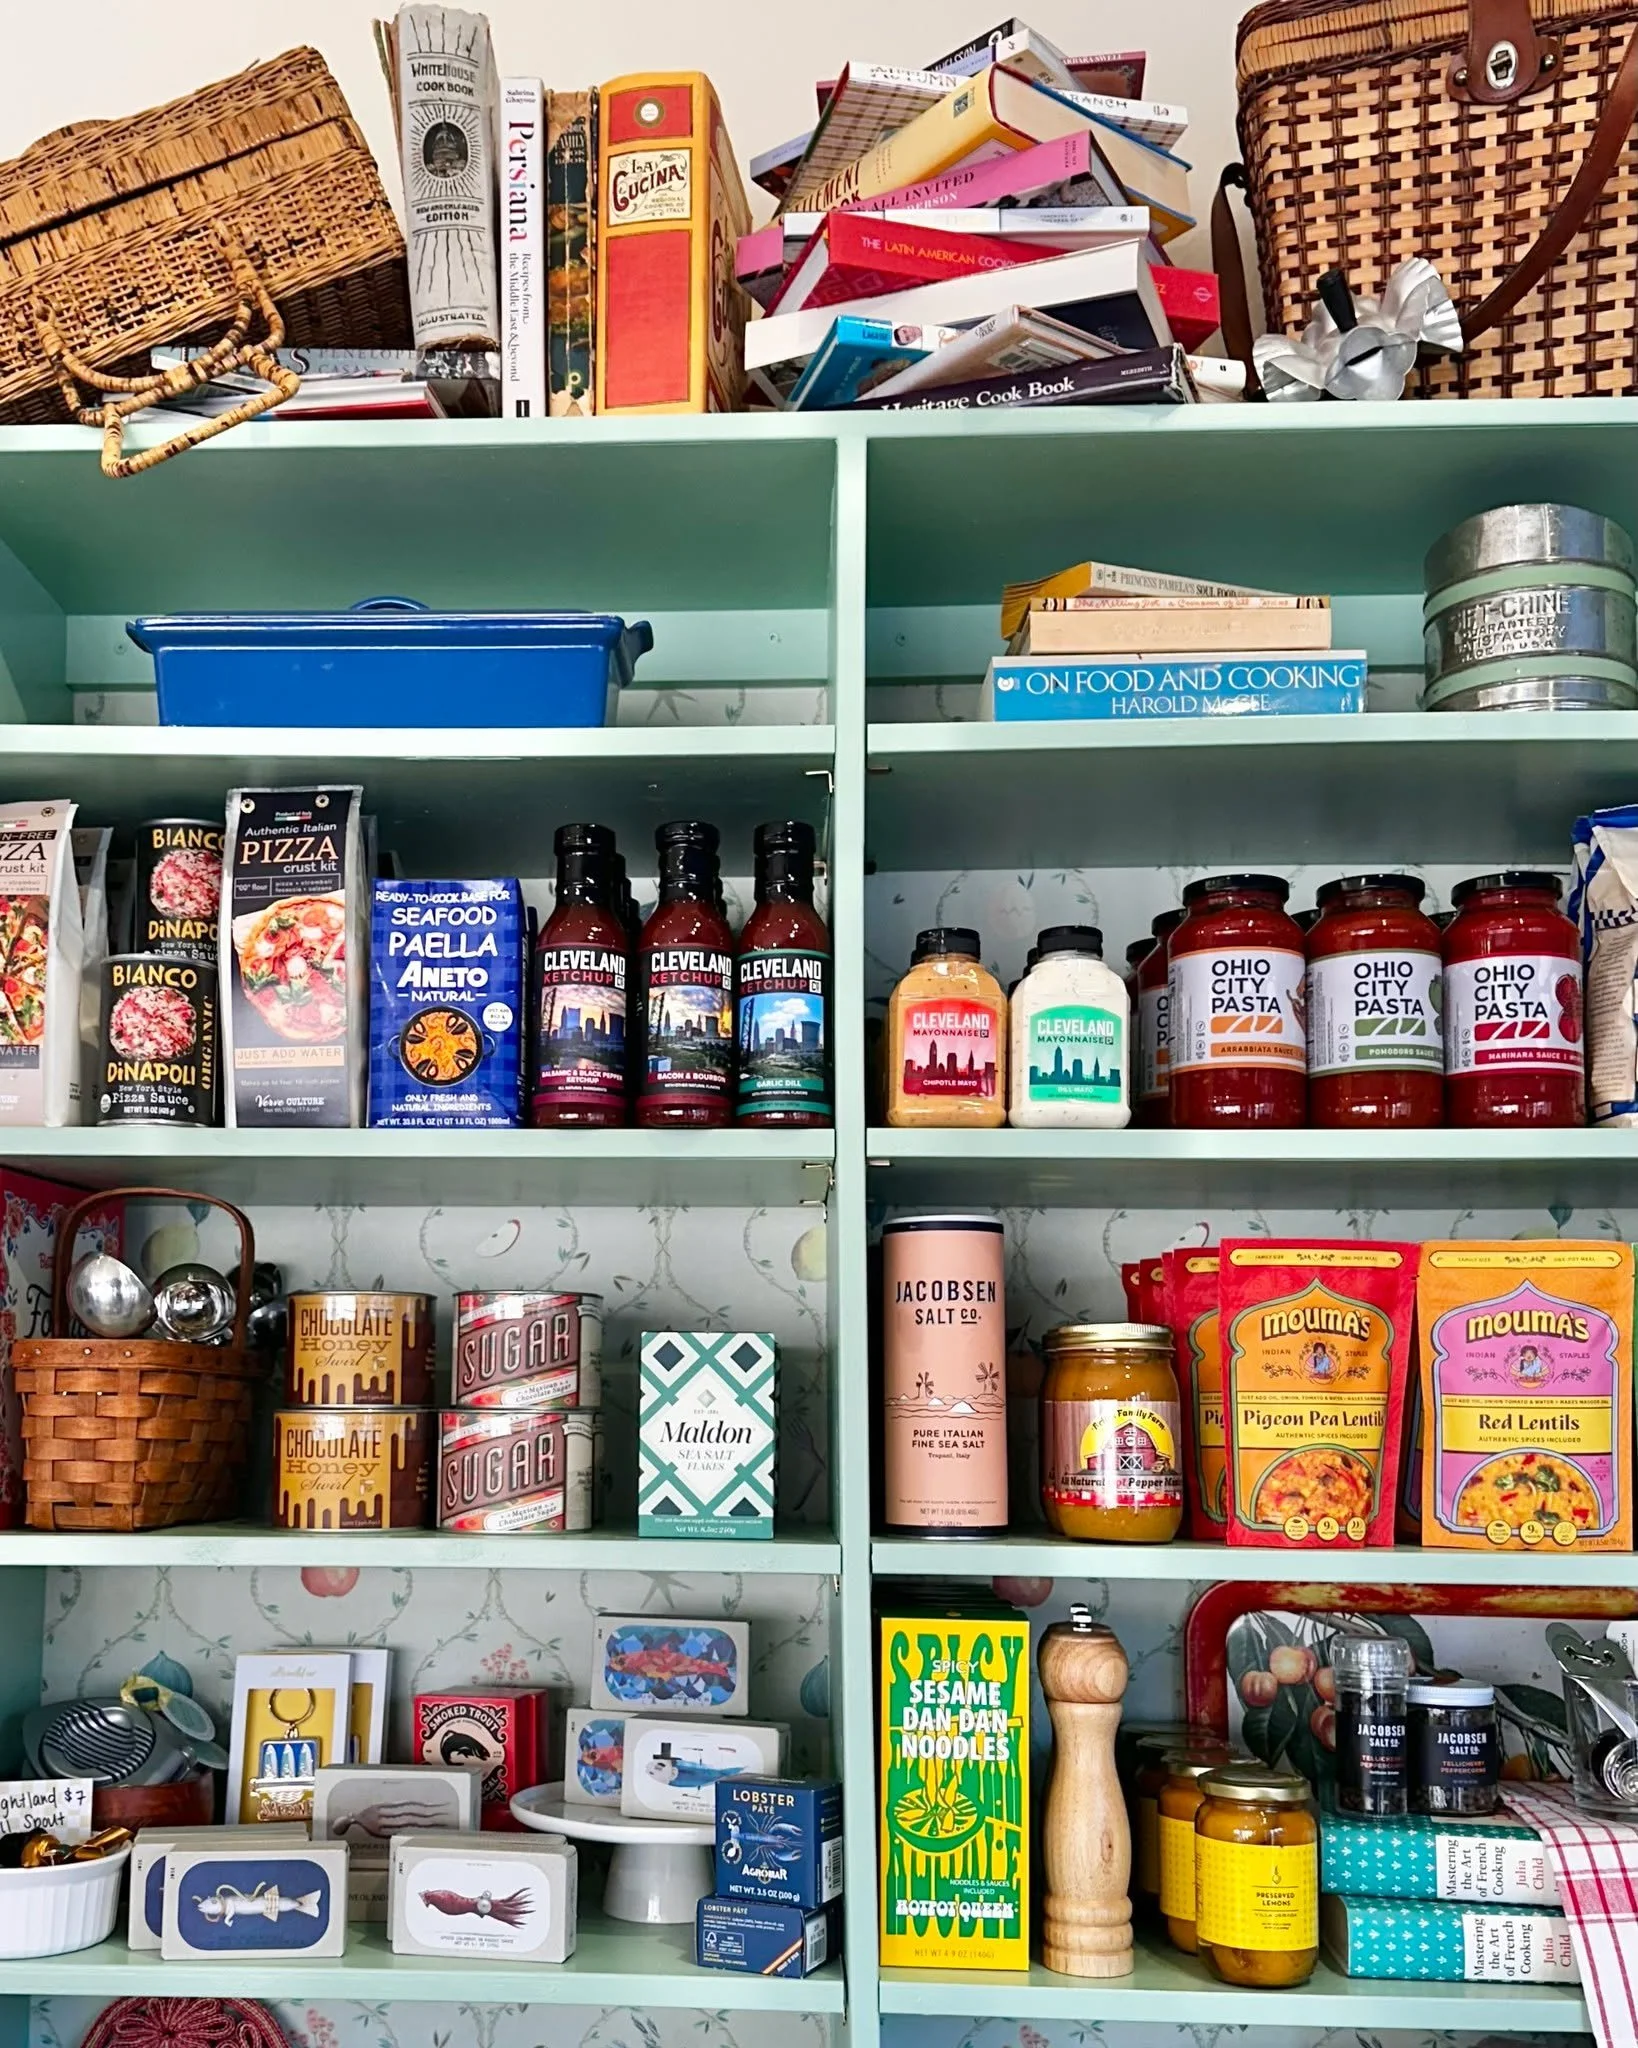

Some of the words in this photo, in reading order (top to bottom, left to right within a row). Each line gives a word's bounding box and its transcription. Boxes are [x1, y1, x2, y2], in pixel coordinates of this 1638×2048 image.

[417, 81, 445, 92] COOK
[447, 82, 474, 96] BOOK
[632, 159, 653, 173] LA
[508, 121, 535, 242] Persiana
[613, 165, 685, 211] CUCINA
[905, 171, 975, 202] INVITED
[426, 211, 469, 223] EDITION
[861, 237, 882, 250] THE
[884, 240, 914, 255] LATIN
[918, 248, 975, 265] AMERICAN
[976, 386, 1022, 406] Cook
[1028, 376, 1075, 398] Book
[1120, 572, 1157, 589] PRINCESS
[1196, 585, 1215, 597] SOUL
[1026, 672, 1071, 694] ON
[1076, 670, 1154, 693] FOOD
[1158, 668, 1222, 692] AND
[1228, 664, 1360, 690] COOKING
[1112, 696, 1196, 715] HAROLD
[245, 825, 299, 837] Authentic
[303, 823, 337, 833] Italian
[240, 836, 339, 864] PIZZA
[30, 863, 45, 873] kit
[284, 862, 316, 873] crust
[321, 860, 337, 871] kit
[376, 891, 460, 904] READY-TO-COOK
[462, 891, 487, 903] BASE
[490, 890, 510, 900] FOR
[391, 906, 497, 926] SEAFOOD
[389, 931, 498, 958] PAELLA
[544, 950, 625, 976] CLEVELAND
[651, 950, 732, 974] CLEVELAND
[1211, 959, 1271, 976] OHIO
[1354, 961, 1413, 978] OHIO
[112, 964, 198, 989] BIANCO
[397, 960, 489, 988] ANETO
[543, 971, 613, 985] KETCHUP
[651, 971, 721, 985] KETCHUP
[740, 959, 821, 983] CLEVELAND
[1474, 964, 1535, 983] OHIO
[740, 979, 808, 995] KETCHUP
[1211, 978, 1265, 995] CITY
[1354, 980, 1408, 997] CITY
[1474, 983, 1529, 1002] CITY
[411, 990, 476, 1002] NATURAL
[1211, 996, 1281, 1013] PASTA
[1355, 998, 1424, 1016] PASTA
[1475, 1002, 1548, 1020] PASTA
[913, 1012, 989, 1029] CLEVELAND
[1037, 1019, 1114, 1036] CLEVELAND
[913, 1029, 979, 1037] MAYONNAISE
[1037, 1036, 1104, 1044] MAYONNAISE
[201, 995, 213, 1090] ORGANIC
[237, 1050, 266, 1060] JUST
[272, 1049, 296, 1058] ADD
[301, 1048, 341, 1057] WATER
[1488, 1050, 1534, 1060] MARINARA
[1536, 1051, 1561, 1060] SAUCE
[107, 1061, 196, 1085] DiNAPOLI
[566, 1076, 600, 1084] KETCHUP
[579, 1070, 601, 1078] BLACK
[657, 1072, 683, 1081] BACON
[693, 1073, 726, 1083] BOURBON
[157, 1085, 182, 1094] Style
[757, 1079, 783, 1088] GARLIC
[785, 1079, 801, 1088] DILL
[923, 1079, 956, 1087] CHIPOTLE
[112, 1093, 145, 1103] Pizza
[150, 1093, 188, 1105] Sauce
[255, 1095, 284, 1108] Verve
[286, 1097, 324, 1106] CULTURE
[405, 1094, 427, 1102] ONLY
[392, 1104, 431, 1112] NATURAL
[433, 1103, 491, 1111] INGREDIENTS
[896, 1280, 996, 1303] JACOBSEN
[301, 1308, 393, 1337] CHOCOLATE
[915, 1308, 955, 1325] SALT
[300, 1338, 391, 1352] Honey
[463, 1313, 570, 1387] SUGAR
[1262, 1348, 1291, 1356] INDIAN
[314, 1352, 369, 1368] Swirl
[1244, 1410, 1304, 1430] Pigeon
[1309, 1411, 1339, 1426] Pea
[1343, 1411, 1384, 1427] Lentils
[1479, 1414, 1512, 1430] Red
[1519, 1414, 1580, 1430] Lentils
[660, 1420, 752, 1444] Maldon
[286, 1429, 381, 1458] CHOCOLATE
[912, 1440, 934, 1448] FINE
[705, 1450, 735, 1460] SALT
[286, 1460, 380, 1477] Honey
[446, 1432, 555, 1508] SUGAR
[1070, 1477, 1105, 1487] Natural
[1128, 1477, 1163, 1489] Pepper
[932, 1660, 979, 1674] SPICY
[909, 1680, 1001, 1706] SESAME
[429, 1706, 467, 1730] SMOKED
[469, 1707, 498, 1732] TROUT
[902, 1707, 951, 1732] DAN
[959, 1708, 1008, 1733] DAN
[1357, 1724, 1406, 1736] JACOBSEN
[1437, 1733, 1487, 1744] JACOBSEN
[901, 1736, 1011, 1762] NOODLES
[1369, 1738, 1389, 1747] SALT
[1449, 1746, 1468, 1755] SALT
[1, 1787, 57, 1819] ghtland
[733, 1789, 794, 1807] LOBSTER
[752, 1803, 775, 1815] PÂTÉ
[24, 1812, 65, 1829] Spout
[1461, 1849, 1472, 1868] Art
[1475, 1842, 1487, 1882] French
[1446, 1839, 1459, 1896] Mastering
[1492, 1846, 1506, 1896] Cooking
[1515, 1860, 1529, 1888] Julia
[1532, 1857, 1544, 1890] Child
[1461, 1871, 1472, 1890] the
[730, 1885, 742, 1893] NET
[743, 1887, 755, 1895] WT.
[768, 1889, 777, 1898] OZ
[1476, 1883, 1487, 1898] of
[704, 1904, 731, 1912] LOBSTER
[896, 1899, 957, 1917] HOTPOT
[959, 1901, 1014, 1922] QUEEN
[1489, 1927, 1499, 1947] Art
[1502, 1920, 1515, 1961] French
[1474, 1918, 1486, 1977] Mastering
[1521, 1923, 1533, 1975] Cooking
[1543, 1937, 1556, 1965] Julia
[1560, 1934, 1571, 1967] Child
[1488, 1950, 1500, 1970] the
[1503, 1962, 1515, 1977] of
